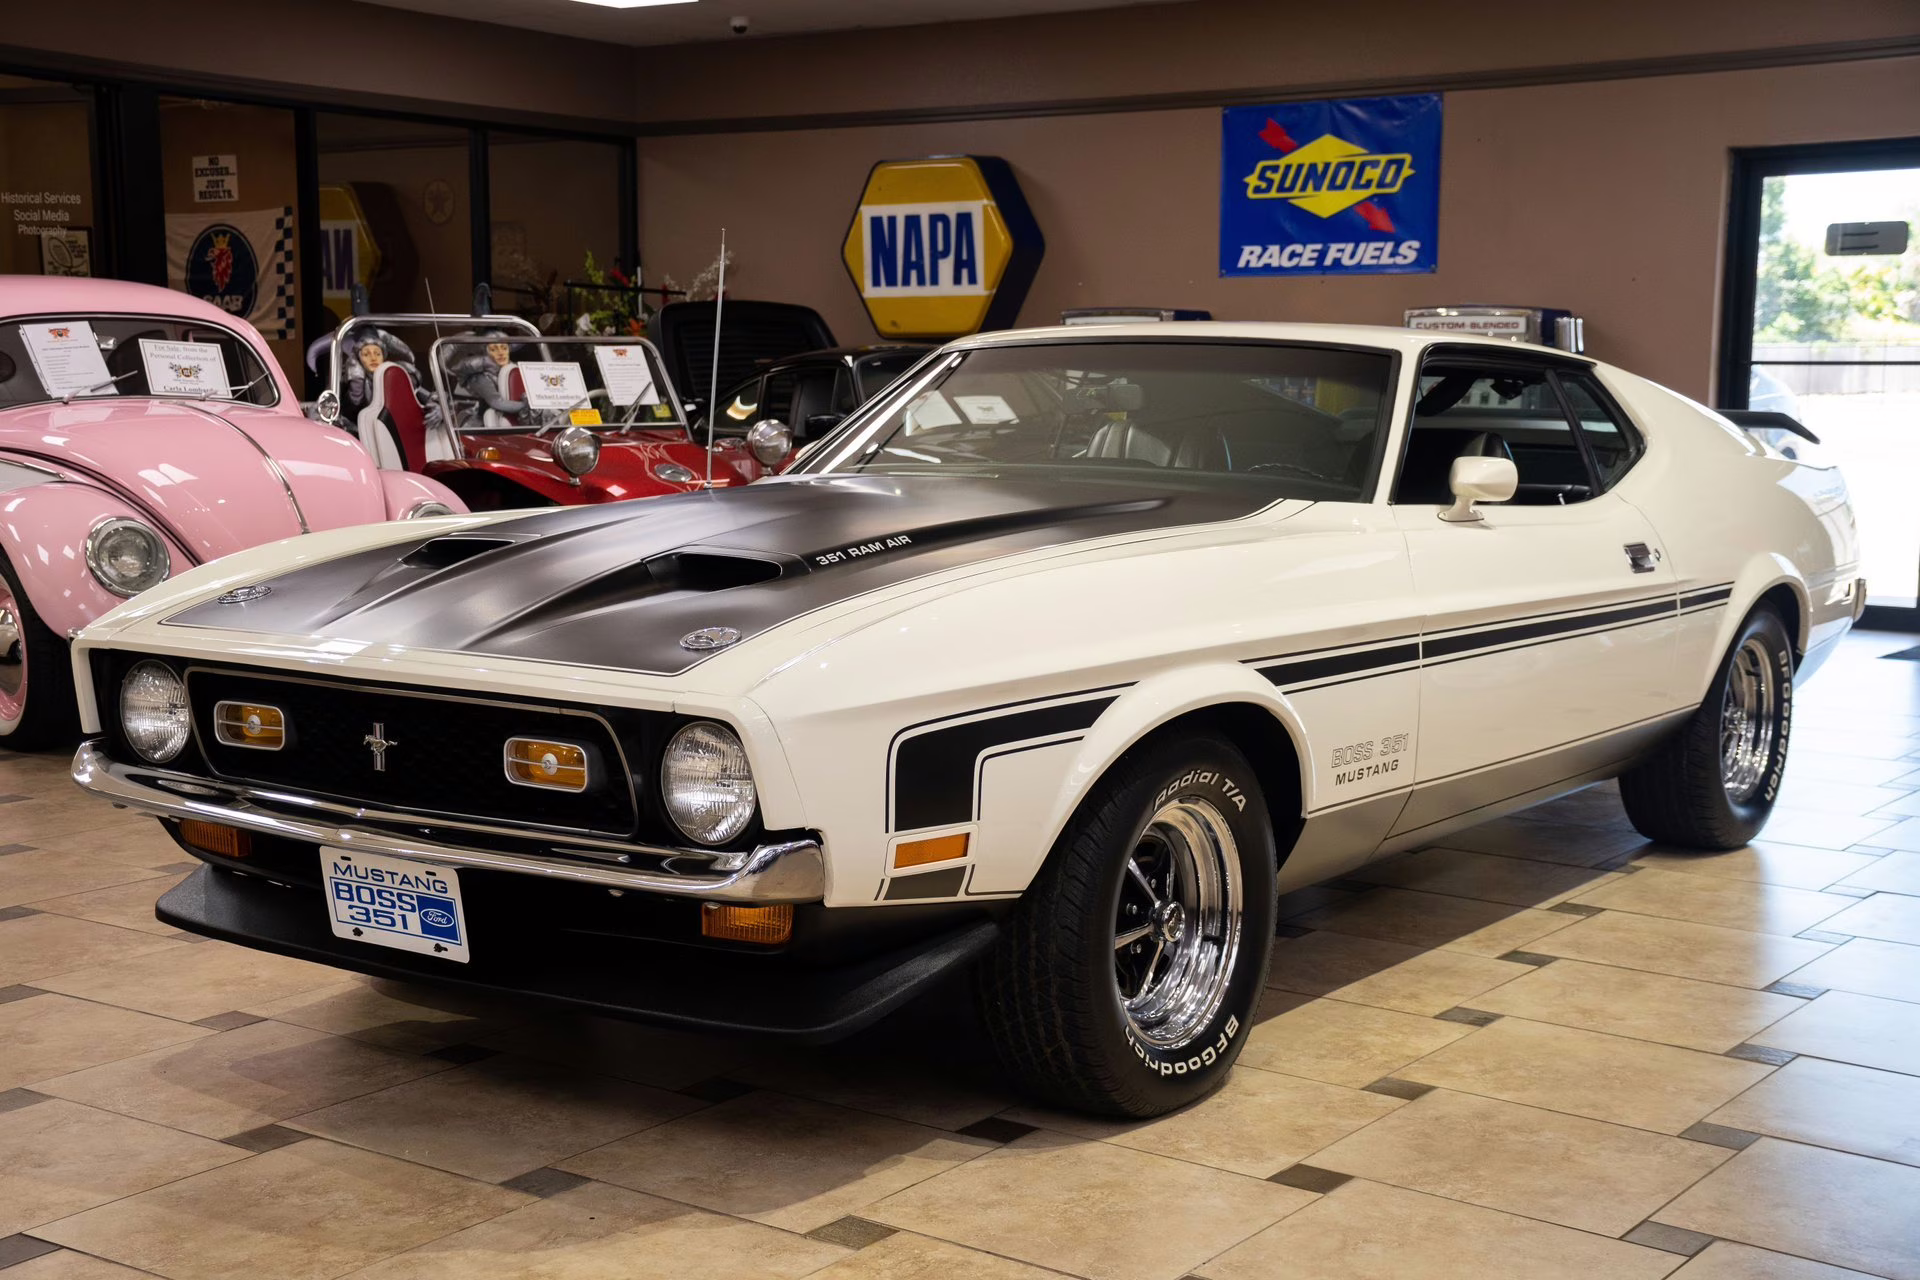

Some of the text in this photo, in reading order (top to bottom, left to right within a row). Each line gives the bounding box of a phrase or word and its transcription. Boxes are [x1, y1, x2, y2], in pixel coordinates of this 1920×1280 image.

[208, 156, 219, 166] NO
[1252, 157, 1408, 195] SUNOCO
[0, 191, 81, 204] Historical Services
[14, 209, 70, 221] Social Media
[18, 224, 67, 238] Photography
[870, 212, 978, 287] NAPA
[1237, 240, 1421, 268] RACE FUELS
[816, 535, 912, 565] 351 RAM AIR
[1764, 650, 1791, 801] BFGoodrich
[1331, 733, 1409, 768] BOSS 351
[1335, 759, 1399, 785] MUSTANG
[333, 862, 449, 894] MUSTANG
[333, 881, 417, 913] BOSS
[348, 904, 409, 930] 351
[427, 911, 448, 925] Ford
[1124, 1014, 1240, 1076] BFGoodrich
